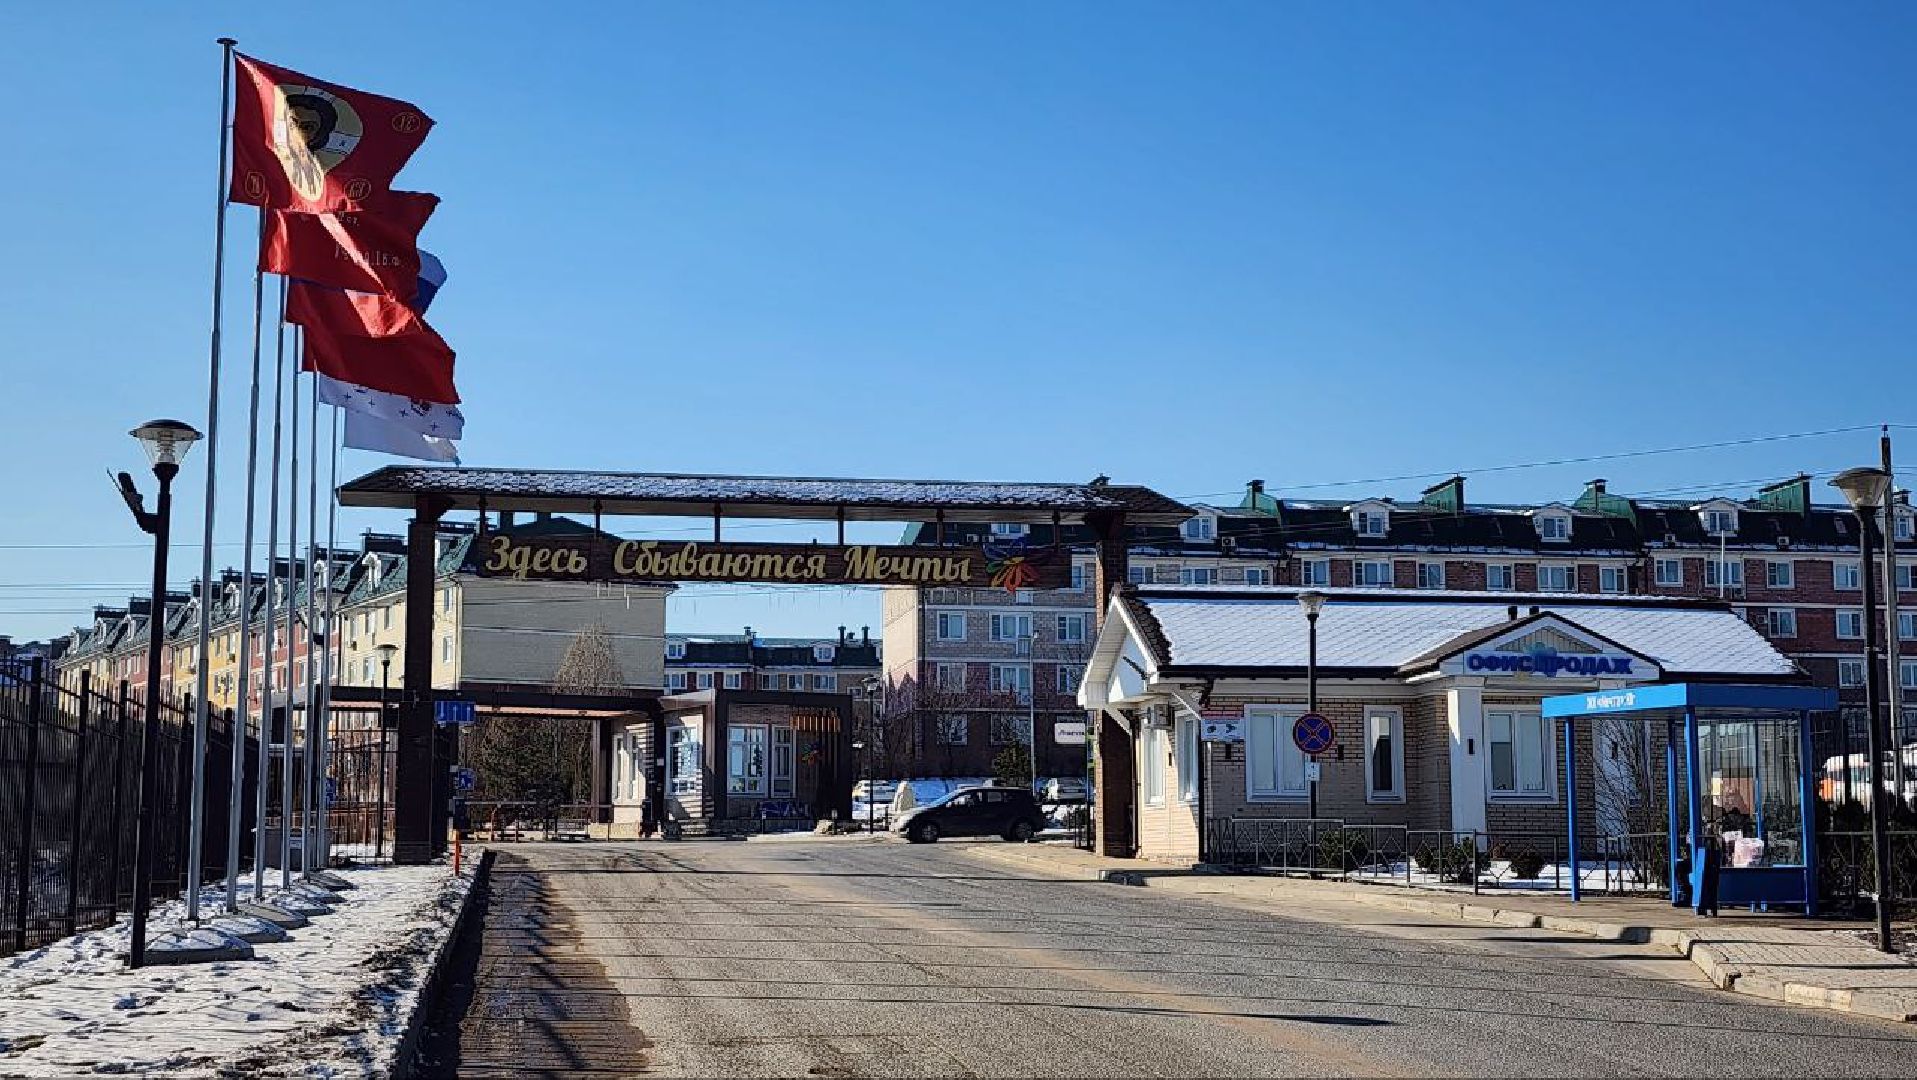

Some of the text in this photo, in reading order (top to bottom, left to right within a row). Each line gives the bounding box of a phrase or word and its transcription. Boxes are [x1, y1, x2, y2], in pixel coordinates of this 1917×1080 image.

[485, 535, 972, 581] Здесь Сбываются Мечты
[1467, 653, 1532, 672] ОФИС
